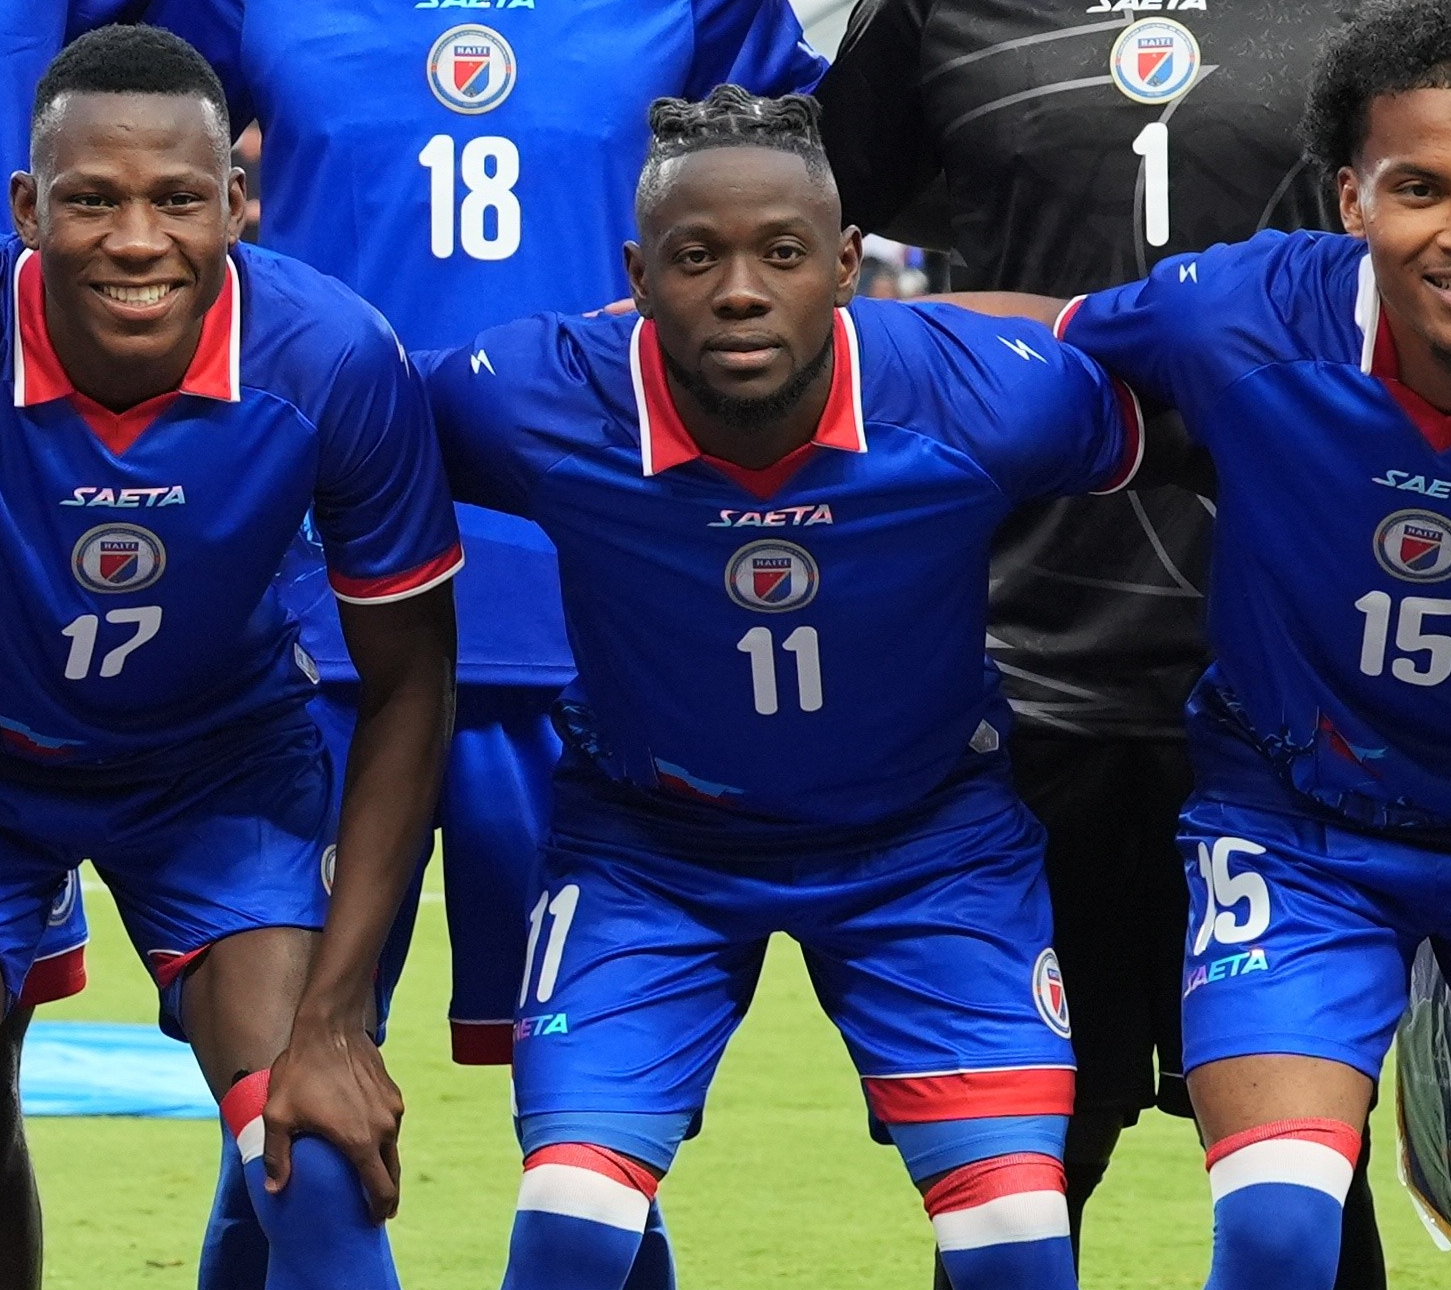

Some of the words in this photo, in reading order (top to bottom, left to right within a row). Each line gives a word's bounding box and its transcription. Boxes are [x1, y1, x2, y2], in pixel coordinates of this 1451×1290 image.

[456, 45, 488, 55] HAITI
[1140, 37, 1172, 48] HAITI
[1132, 122, 1169, 247] 1
[418, 134, 521, 260] 18
[59, 485, 186, 508] SAETA
[707, 504, 834, 527] SAETA
[1407, 526, 1440, 540] HAITI
[103, 542, 136, 550] HAITI
[755, 559, 789, 567] HAITI
[61, 605, 163, 680] 17
[737, 626, 823, 715] 11
[1194, 837, 1271, 956] 15
[519, 884, 580, 1009] 11
